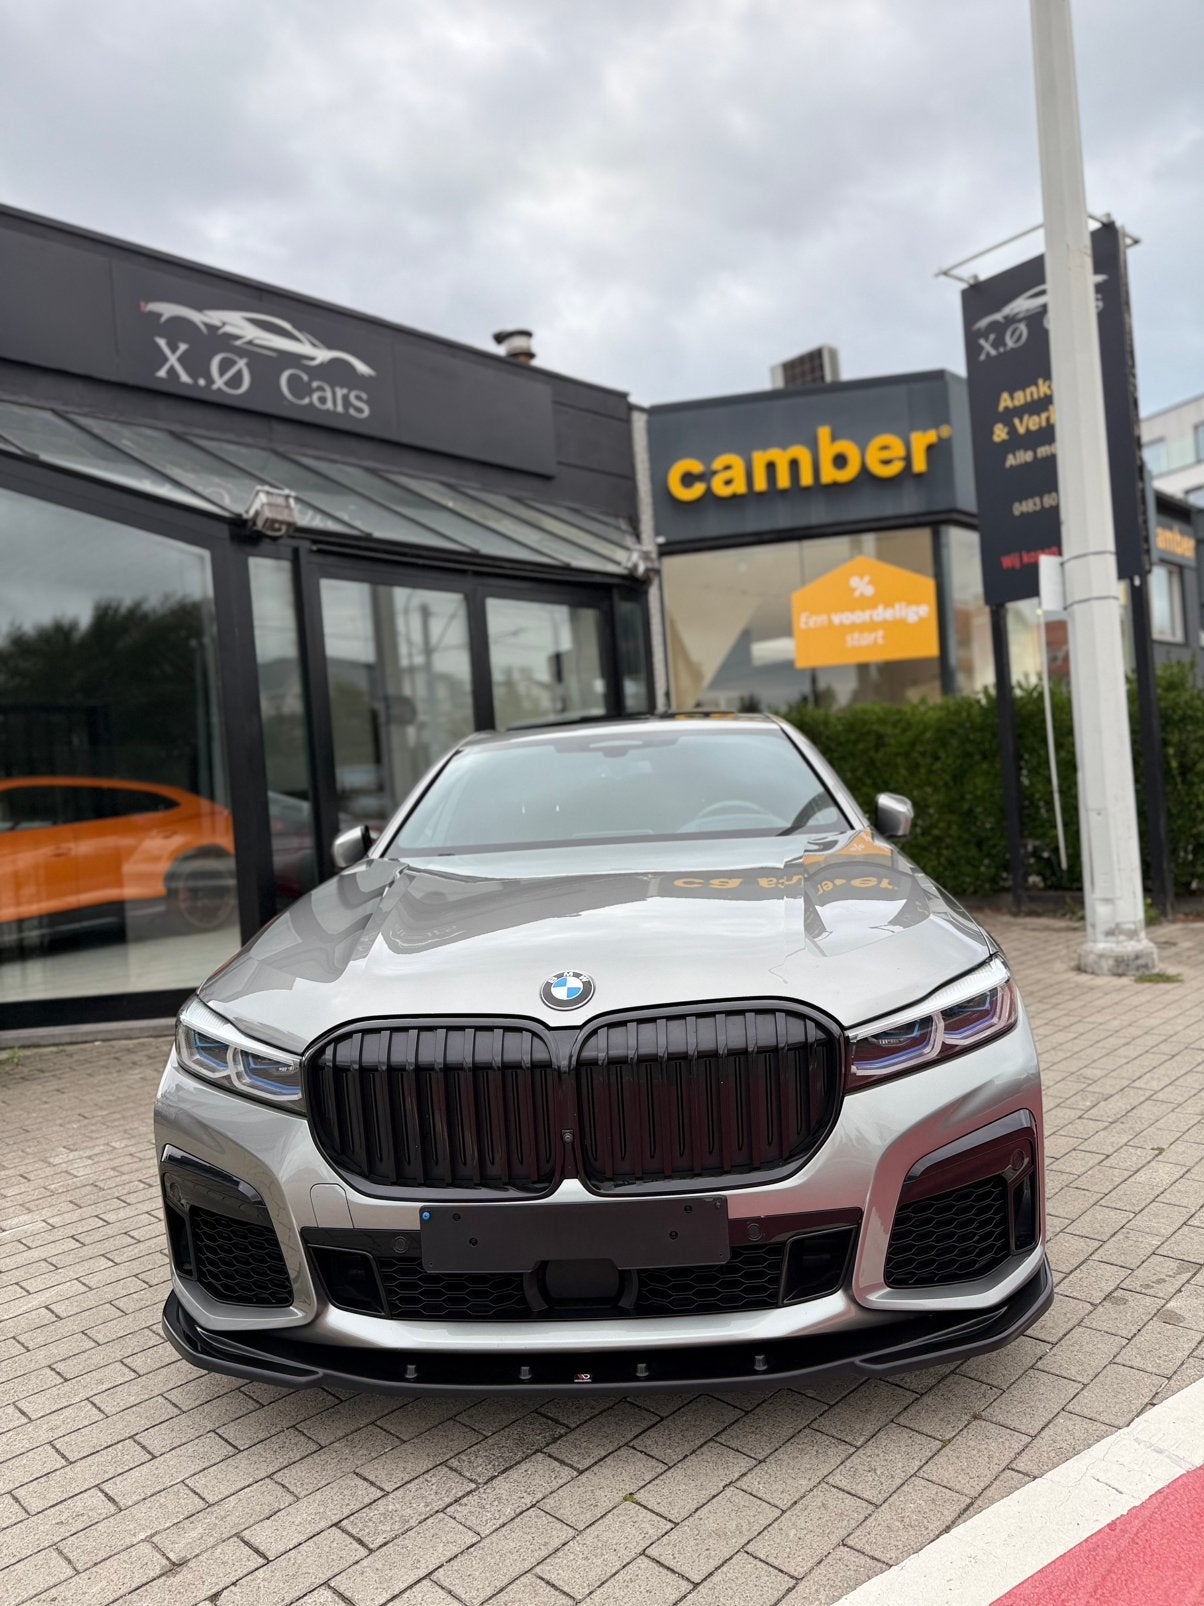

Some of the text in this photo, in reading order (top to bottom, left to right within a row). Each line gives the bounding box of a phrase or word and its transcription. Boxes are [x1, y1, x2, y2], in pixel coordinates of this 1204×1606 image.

[153, 336, 371, 419] X.Ø Cars
[997, 377, 1053, 412] Aank
[992, 422, 1010, 444] &
[1005, 448, 1035, 469] Alle
[799, 602, 929, 629] Een voordelige
[845, 628, 885, 649] start
